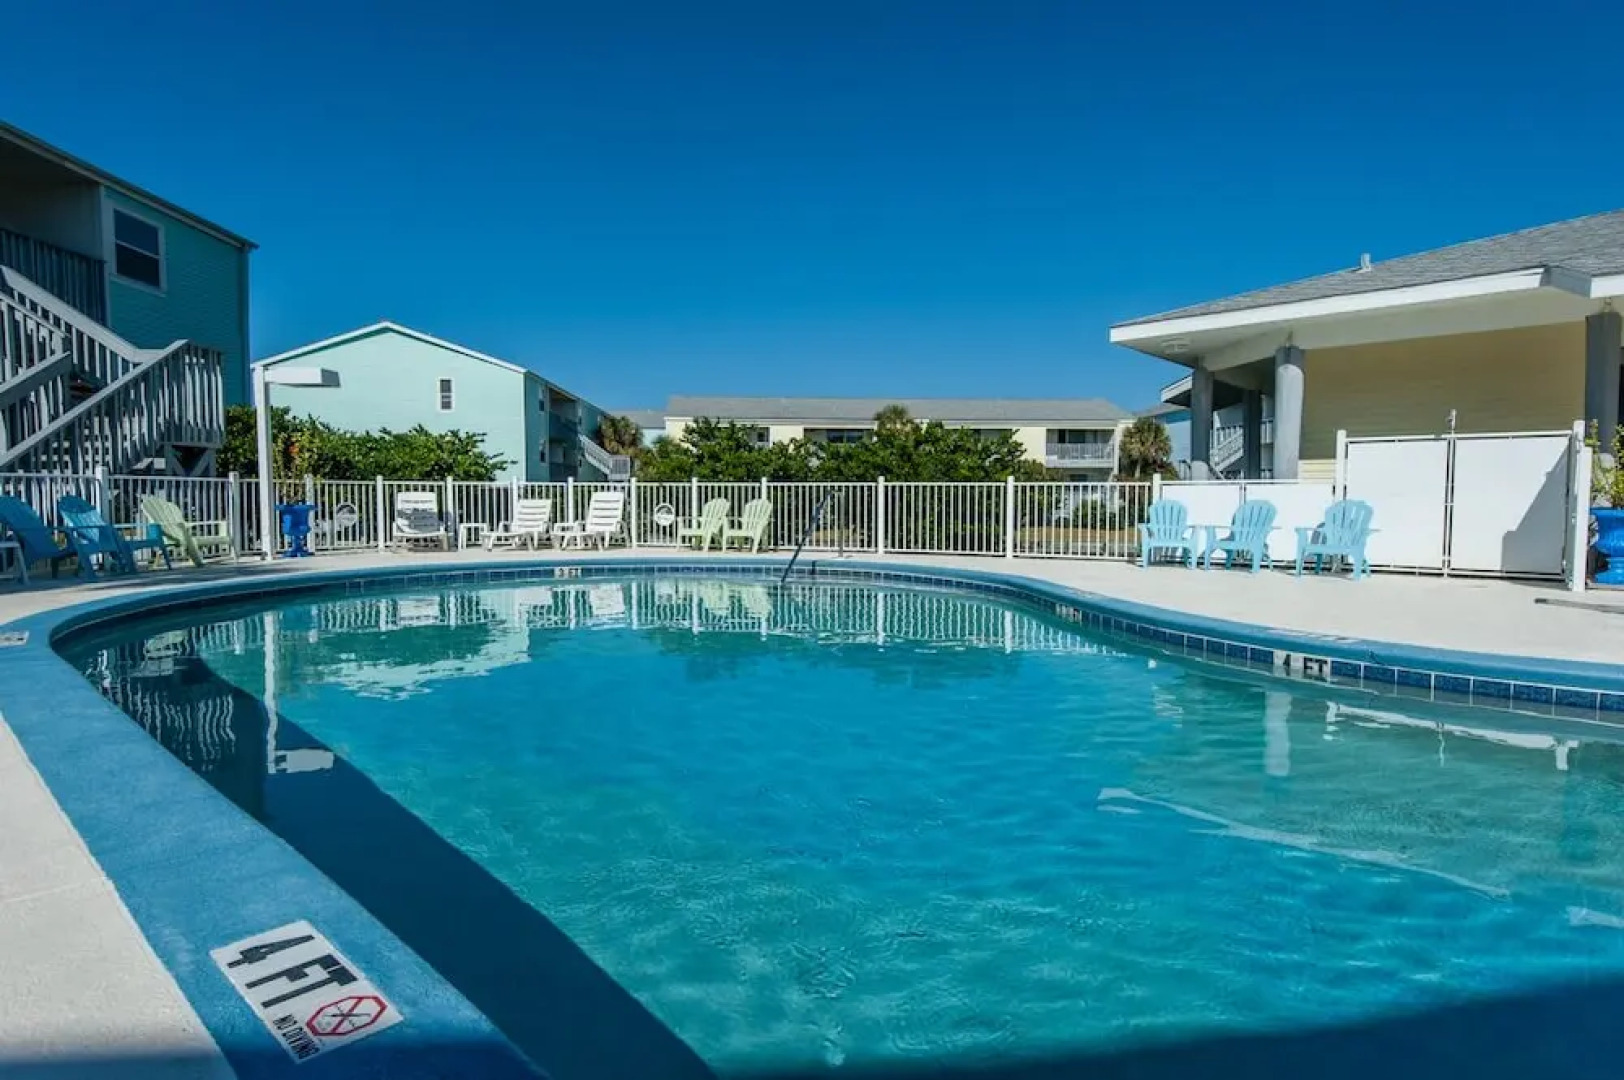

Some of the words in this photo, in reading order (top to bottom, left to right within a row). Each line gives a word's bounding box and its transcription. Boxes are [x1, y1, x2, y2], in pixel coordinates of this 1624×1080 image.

[1303, 656, 1328, 673] FT
[227, 934, 315, 969] 4
[245, 953, 358, 1009] FT
[273, 1014, 298, 1031] NO
[282, 1026, 320, 1060] DIVING
